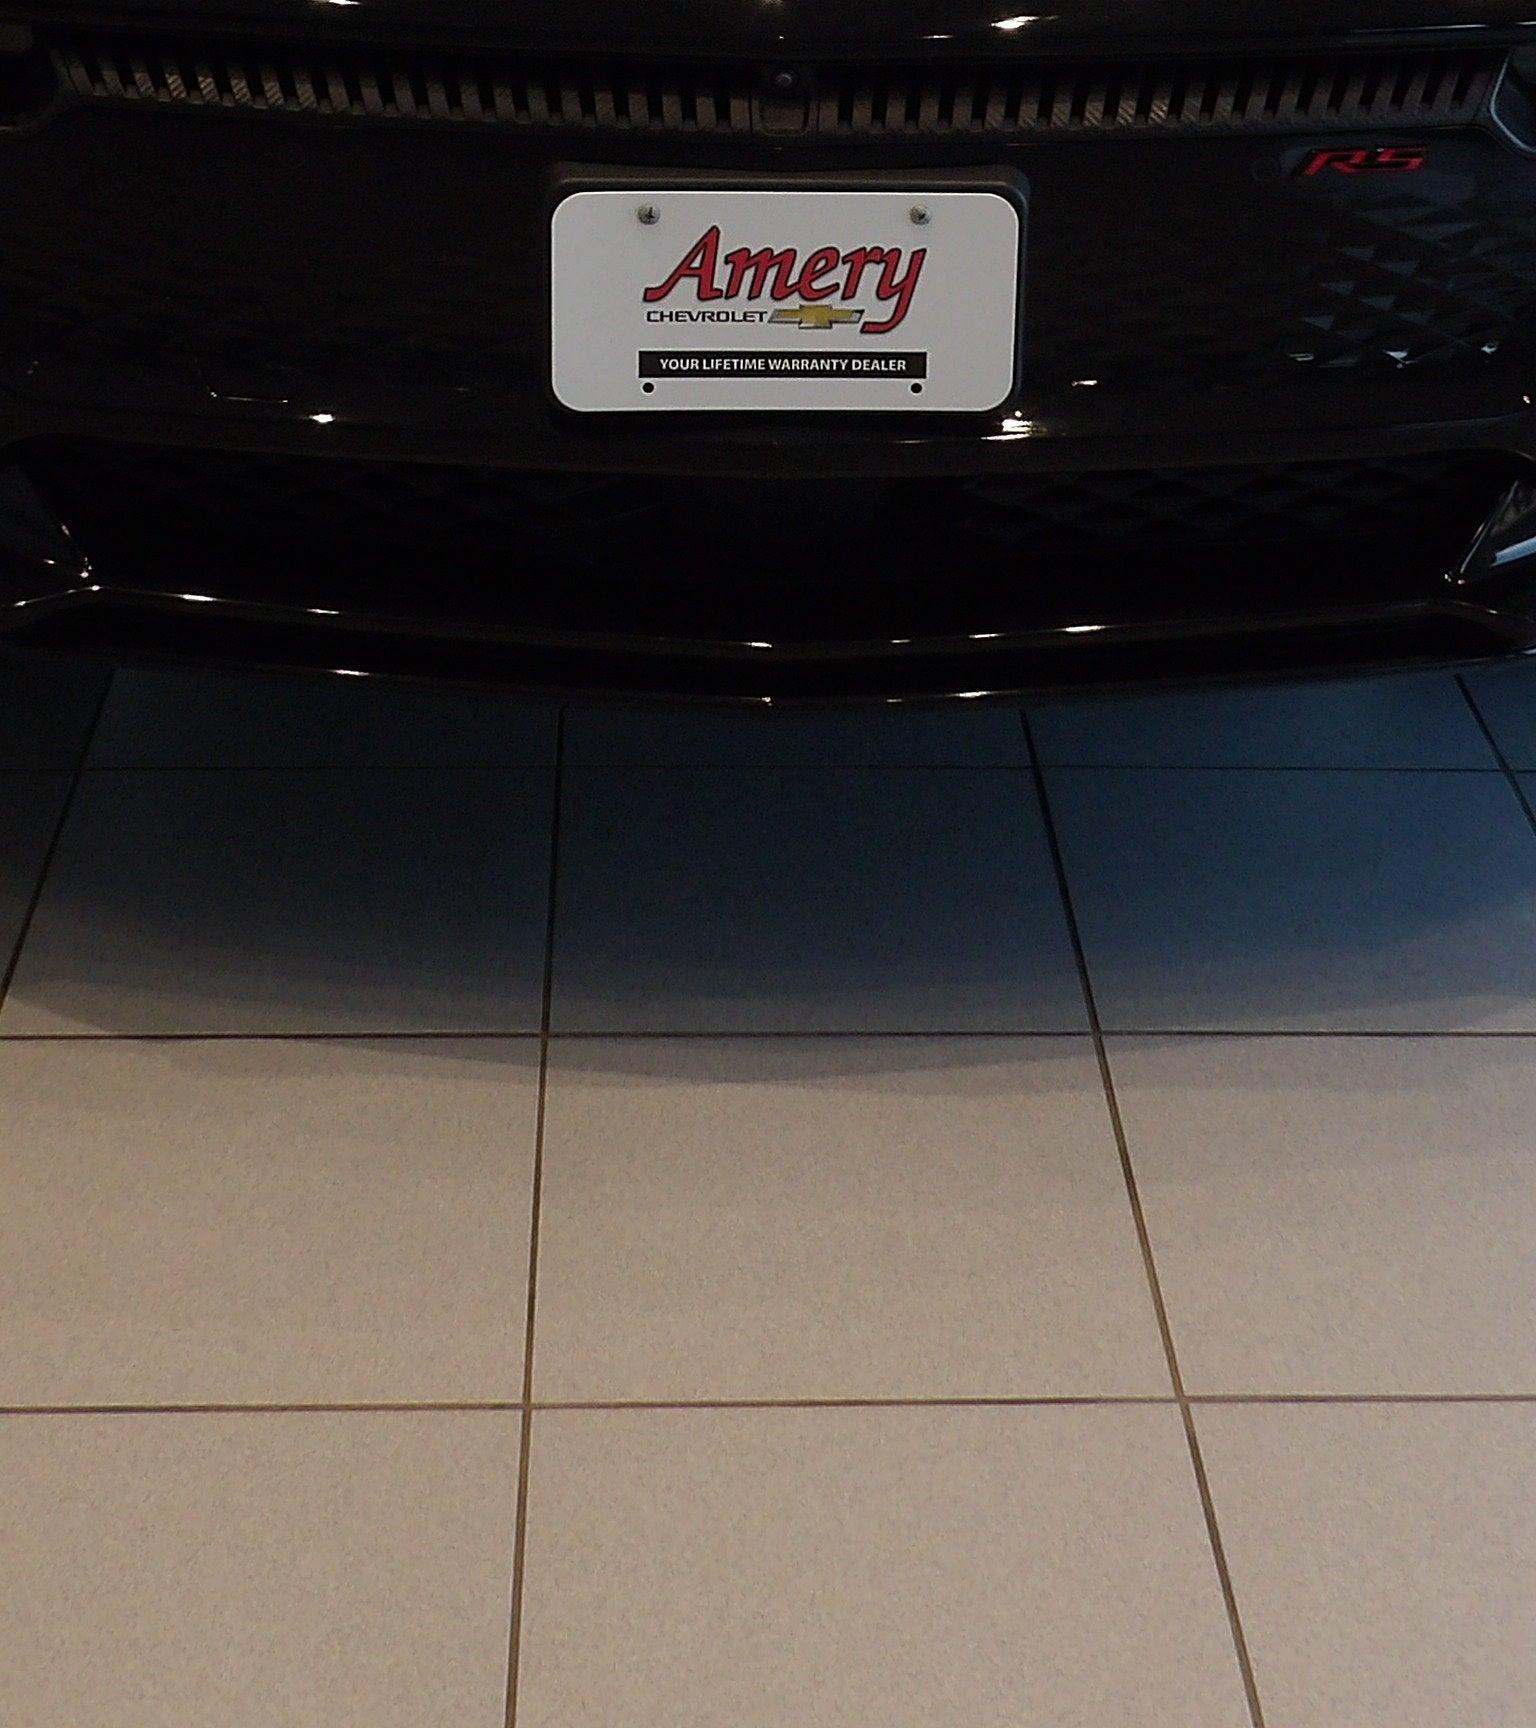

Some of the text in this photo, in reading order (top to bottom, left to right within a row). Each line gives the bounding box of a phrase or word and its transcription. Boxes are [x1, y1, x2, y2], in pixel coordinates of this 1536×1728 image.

[1301, 147, 1431, 176] RS
[641, 224, 928, 335] Amery
[646, 310, 768, 323] CHEVROLET
[659, 358, 907, 371] YOUR LIFETIME WARRANTY DEALER
